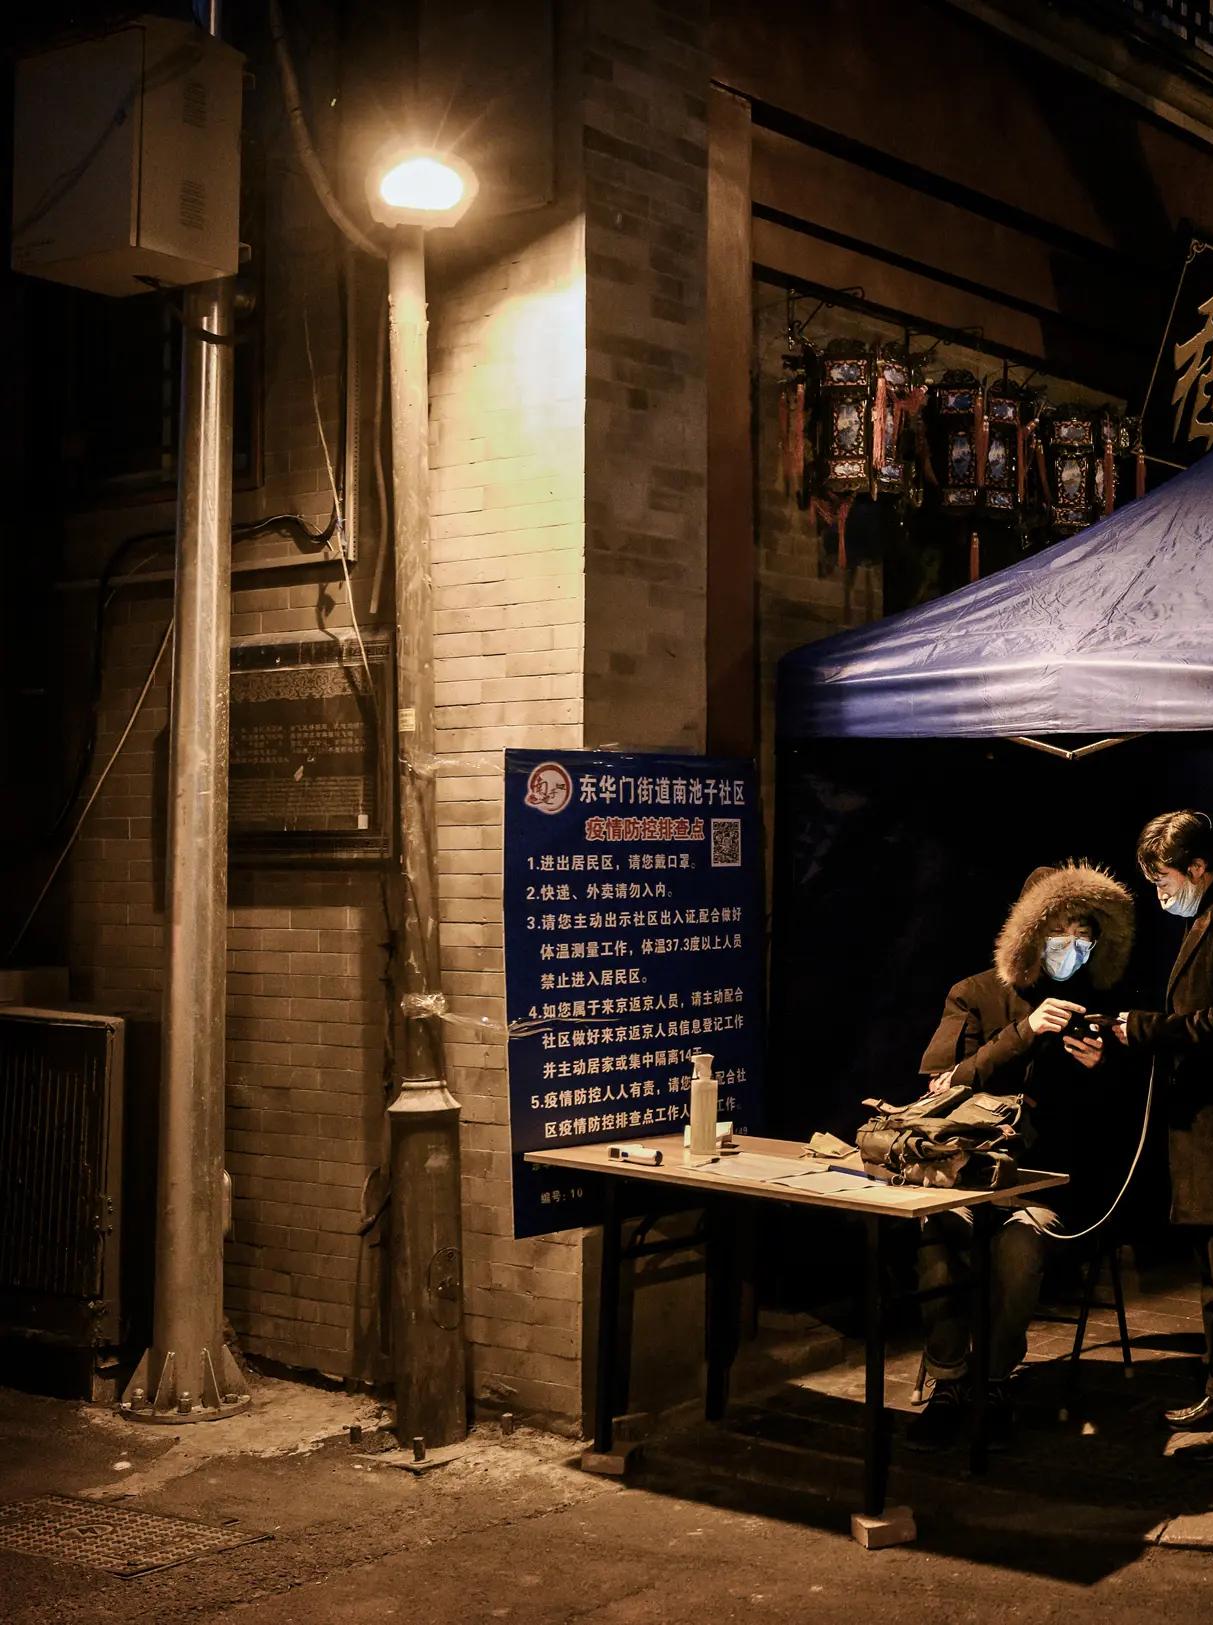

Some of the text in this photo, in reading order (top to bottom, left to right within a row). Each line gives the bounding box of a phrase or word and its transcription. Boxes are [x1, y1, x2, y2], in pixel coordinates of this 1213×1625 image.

[579, 774, 746, 806] 东华门街道南池子社区
[585, 816, 706, 842] 疫情防控排查点
[540, 968, 649, 991] 禁止进入居民区。
[541, 1014, 745, 1050] 社区做好来京返京人员信息登记工作
